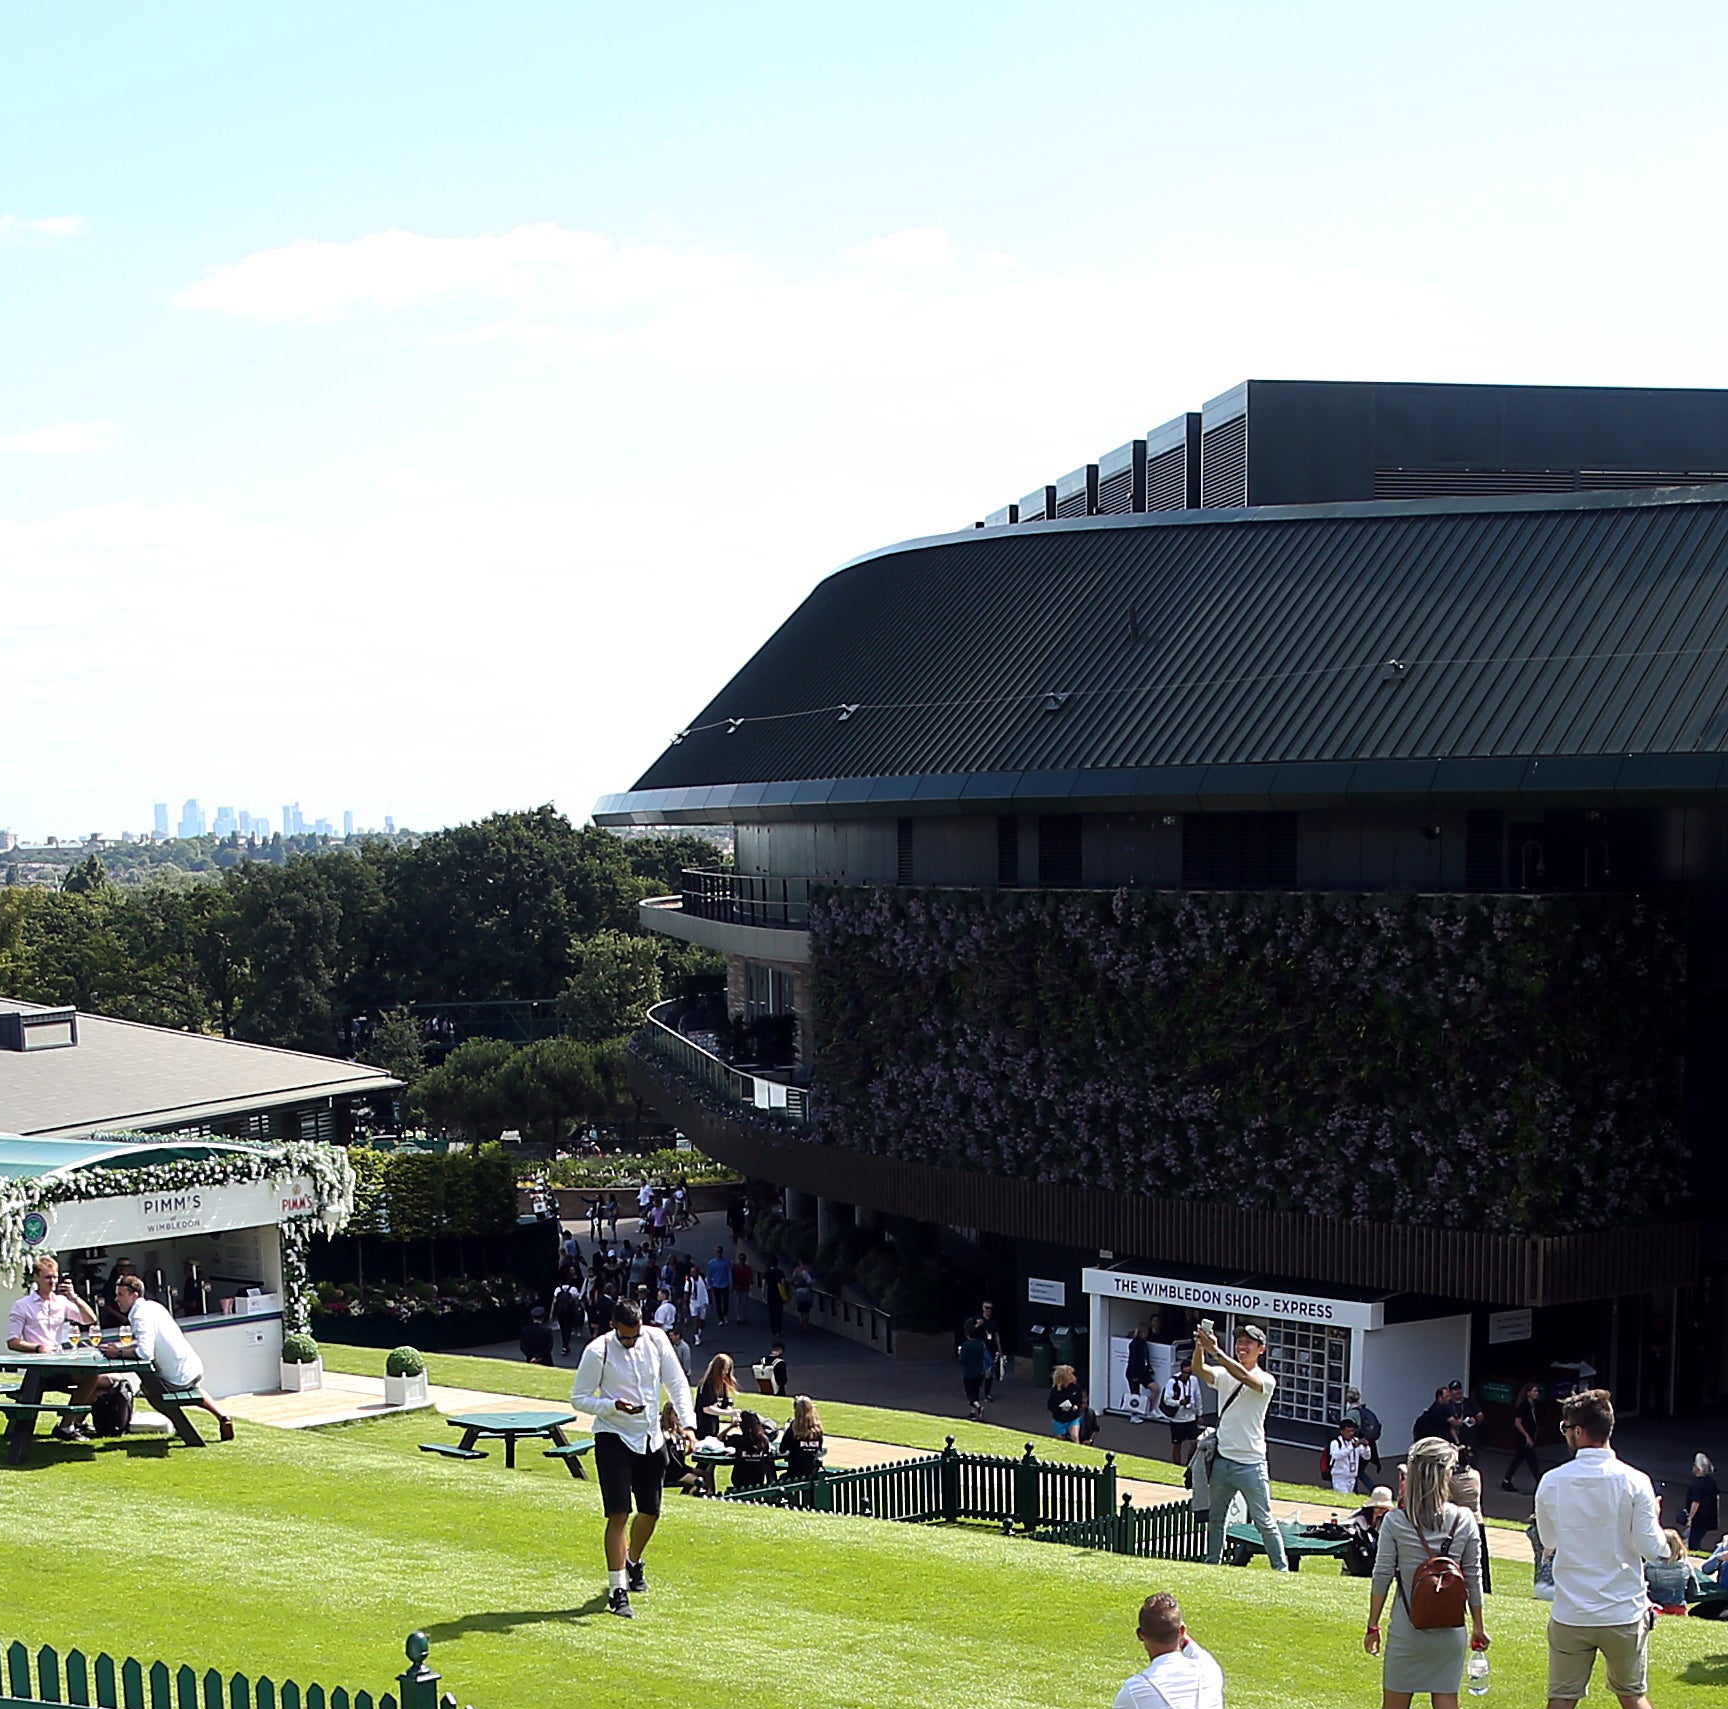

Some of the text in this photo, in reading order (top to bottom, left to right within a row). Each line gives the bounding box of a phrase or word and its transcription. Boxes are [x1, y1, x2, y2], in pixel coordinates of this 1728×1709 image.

[144, 1195, 201, 1214] PIMM'S
[147, 1219, 201, 1232] WIMBLEDON
[1114, 1278, 1137, 1293] THE
[1142, 1282, 1221, 1305] WIMBLEDON
[1225, 1293, 1260, 1310] SHOP
[1273, 1299, 1333, 1319] EXPRESS
